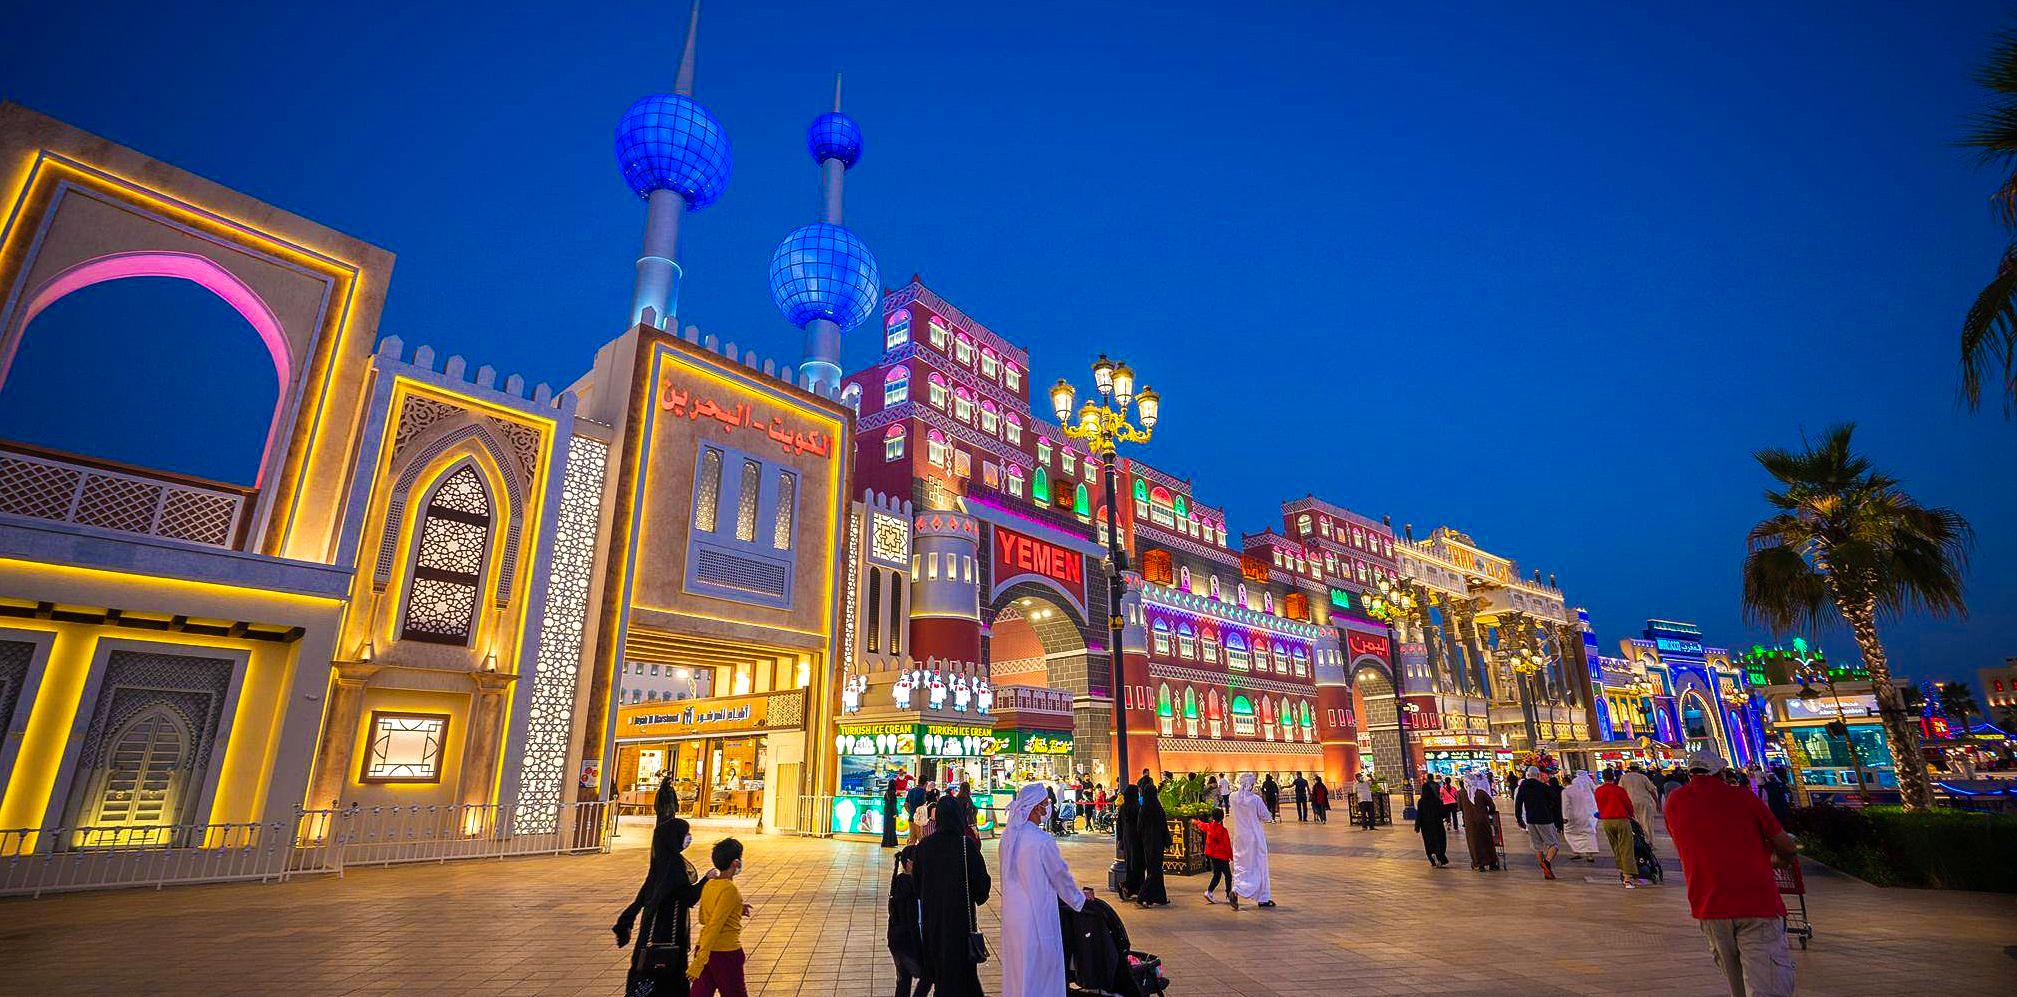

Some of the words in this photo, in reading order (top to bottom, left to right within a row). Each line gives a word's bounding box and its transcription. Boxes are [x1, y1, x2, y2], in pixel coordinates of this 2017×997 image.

[661, 378, 752, 433] البحرين
[768, 415, 835, 459] الكويت
[998, 530, 1081, 584] YEMEN
[1350, 636, 1389, 656] اليمن
[1750, 673, 1767, 685] KSA
[841, 725, 871, 735] TURKISH
[872, 725, 884, 735] ICE
[885, 724, 912, 734] CREAM
[929, 725, 958, 736] TURKISH
[958, 726, 970, 736] ICE
[970, 727, 992, 737] CREAM
